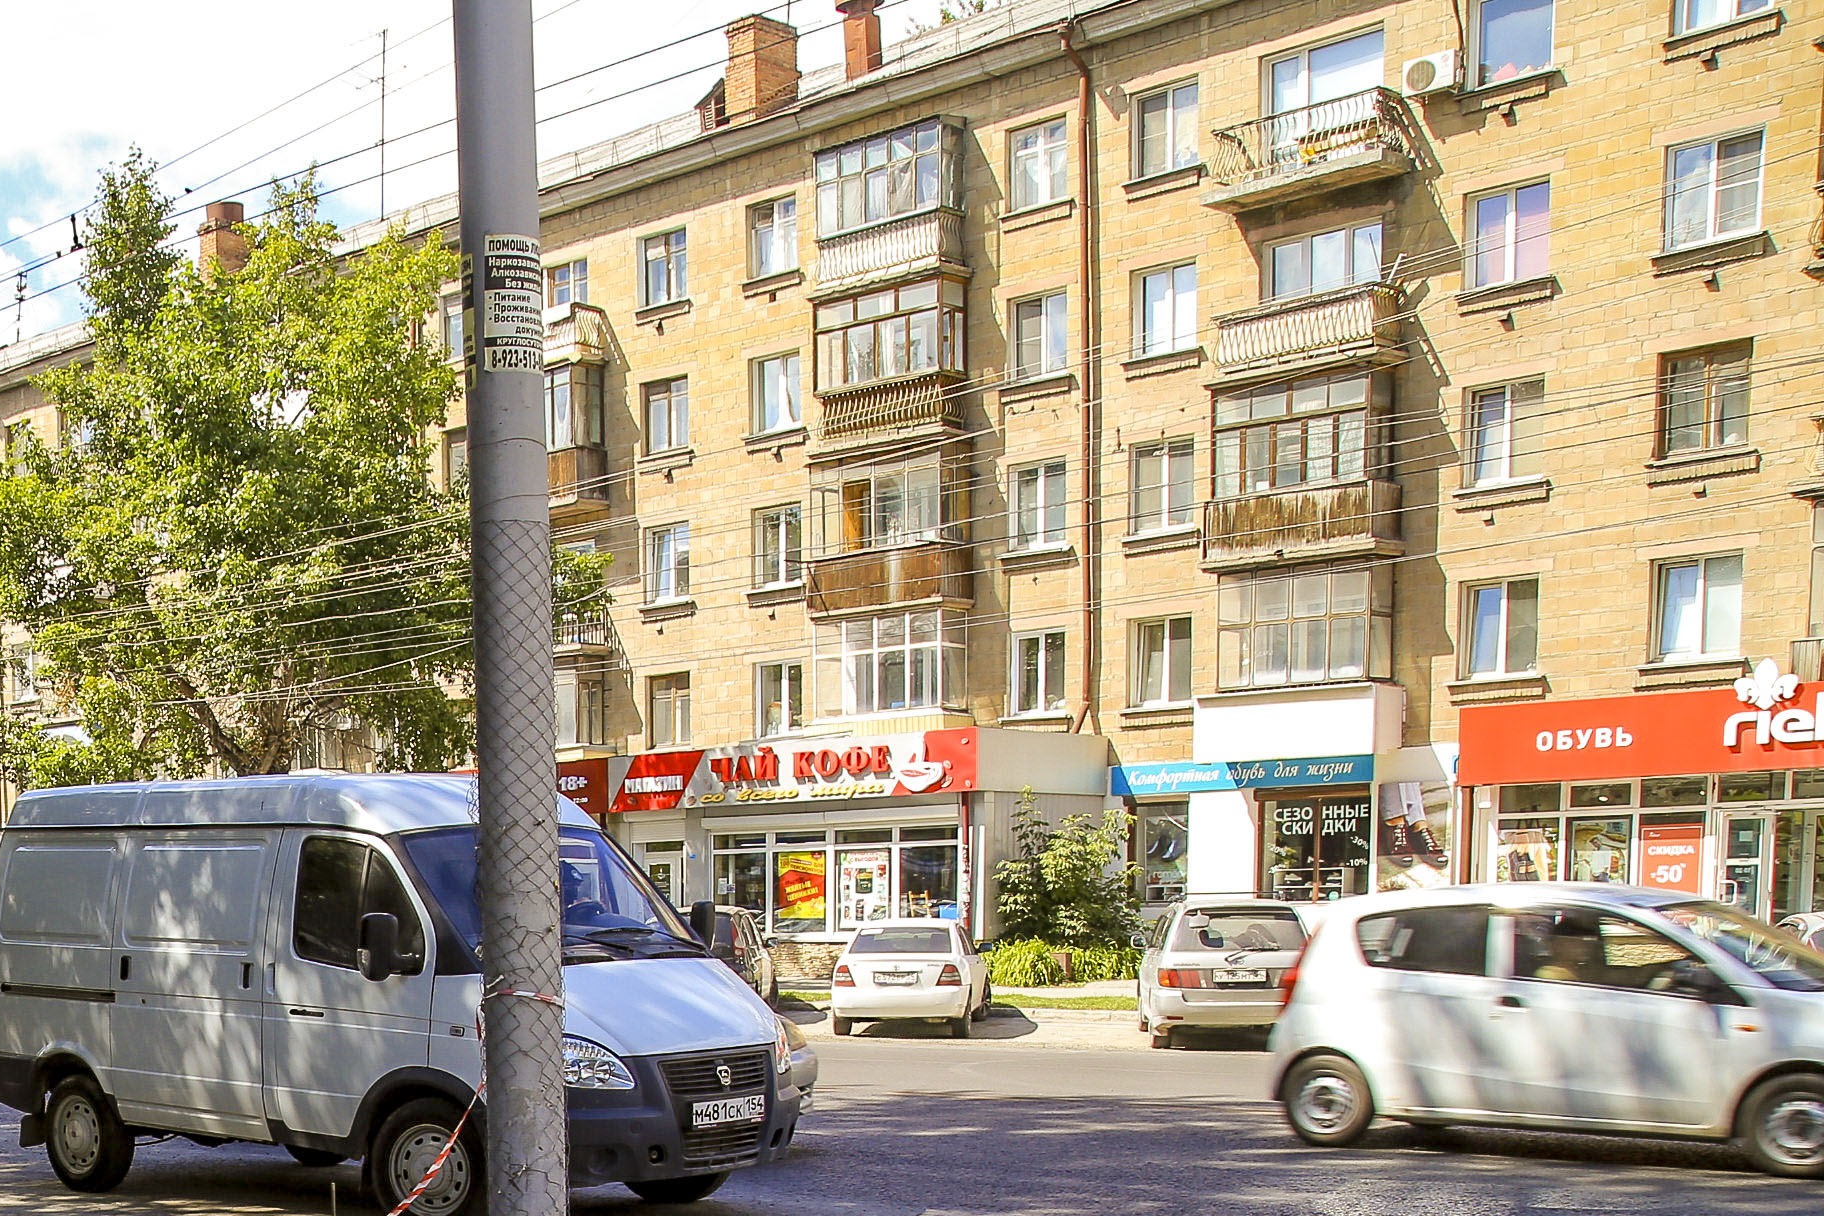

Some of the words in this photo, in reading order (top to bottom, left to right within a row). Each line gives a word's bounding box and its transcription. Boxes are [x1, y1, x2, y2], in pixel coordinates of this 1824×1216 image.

[488, 239, 530, 254] ПОМОЩЬ
[505, 278, 522, 288] Без
[494, 292, 531, 303] Питание
[1536, 726, 1634, 752] ОБУВЬ
[708, 745, 778, 783] ЧАЙ
[792, 745, 890, 778] КОФЕ
[558, 776, 588, 791] 18+
[624, 775, 684, 794] МАГАЗИН
[1128, 768, 1219, 791] Комфортная
[1226, 762, 1266, 788] обувь
[1274, 761, 1298, 778] для
[1306, 762, 1354, 782] жизни
[700, 792, 725, 803] со
[736, 786, 799, 802] всего
[810, 782, 886, 800] мира
[1274, 807, 1313, 821] СЕЗО
[1322, 804, 1369, 819] ННЫЕ
[1282, 821, 1313, 835] СКИ
[1321, 819, 1357, 836] ДКИ
[1350, 835, 1369, 850] -30%
[1647, 845, 1695, 856] СКИДКА
[1346, 857, 1368, 867] -10%
[695, 1101, 743, 1124] М481СК
[745, 1096, 763, 1112] 154
